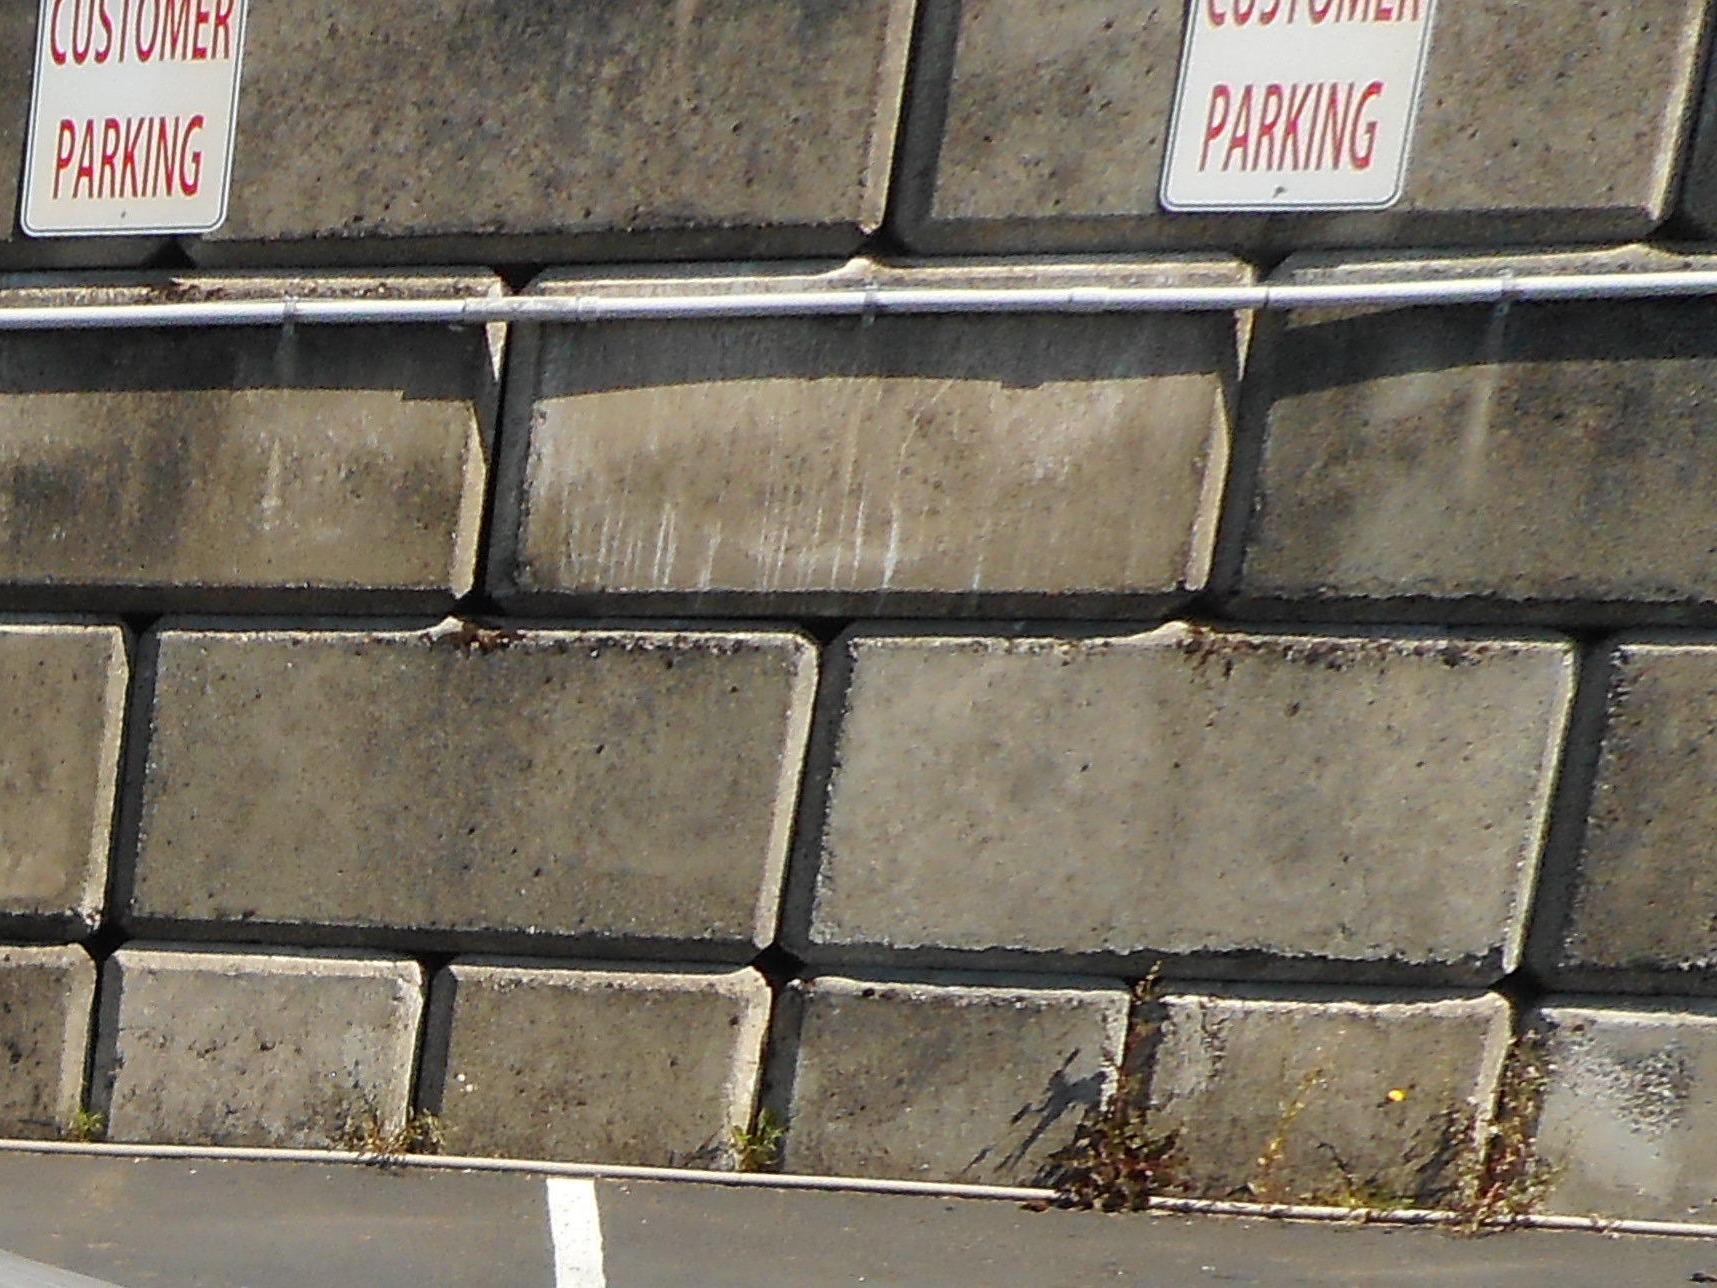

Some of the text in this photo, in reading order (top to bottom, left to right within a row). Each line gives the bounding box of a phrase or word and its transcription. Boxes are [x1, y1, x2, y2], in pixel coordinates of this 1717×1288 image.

[50, 0, 234, 66] CUSTOMER
[52, 114, 204, 199] PARKING
[1198, 80, 1384, 172] PARKING
